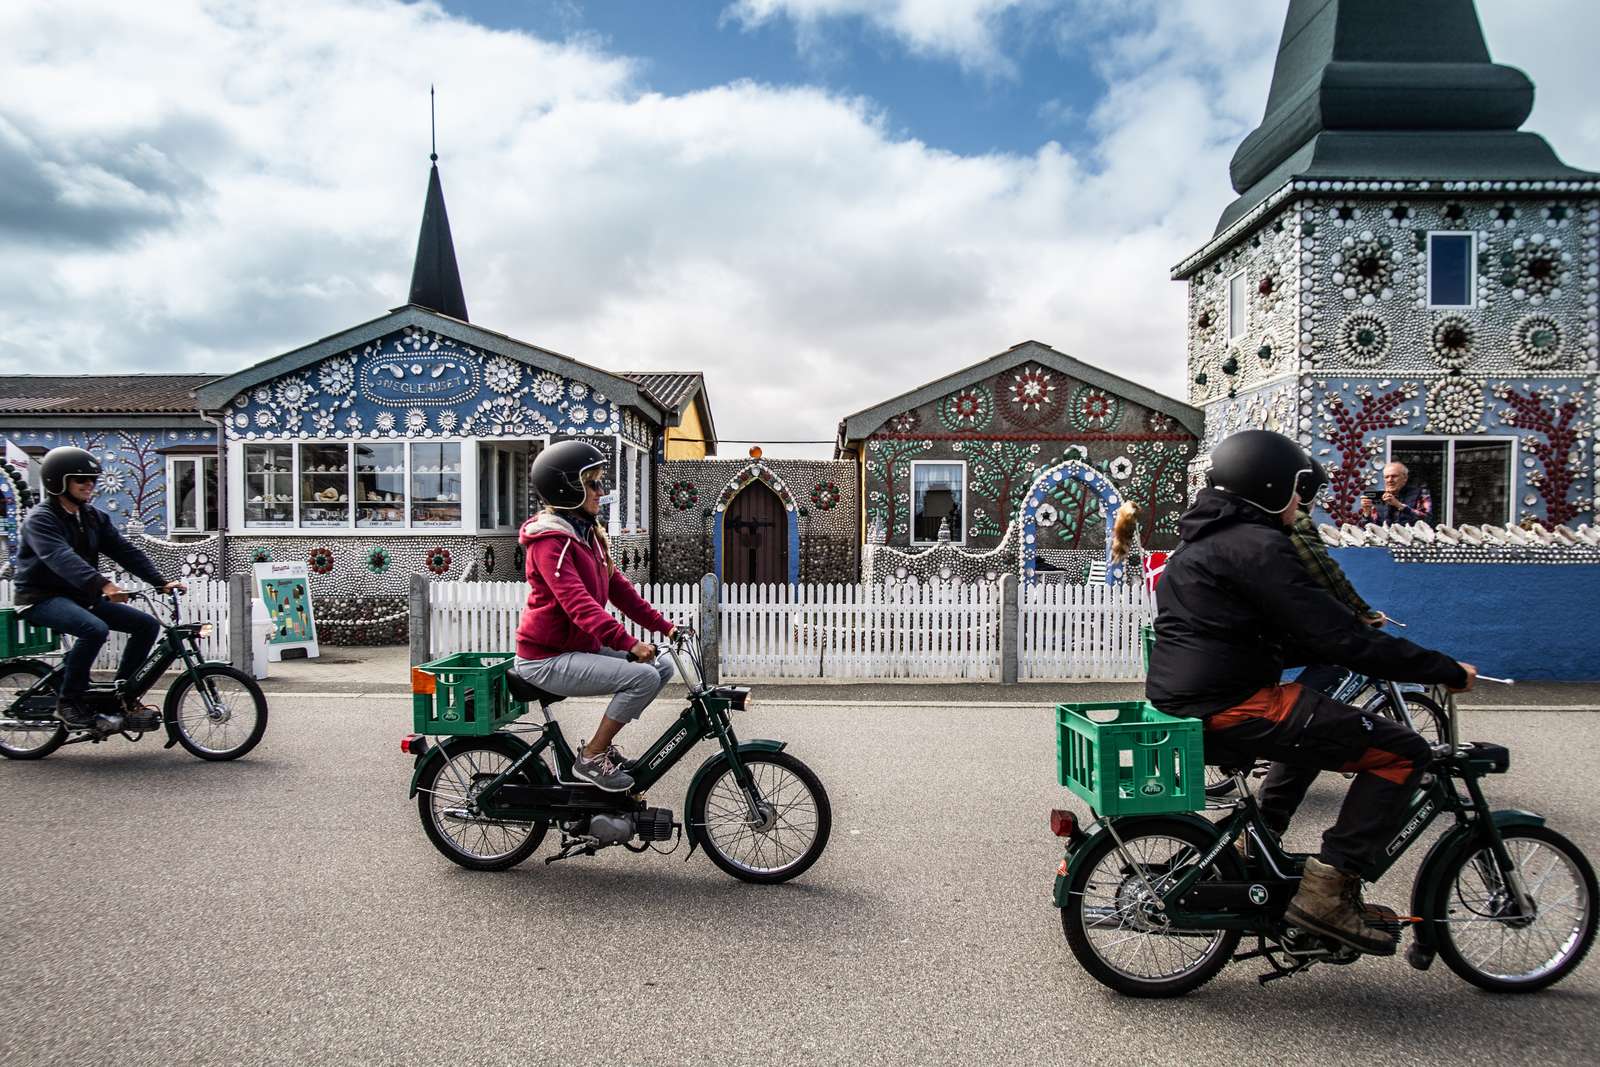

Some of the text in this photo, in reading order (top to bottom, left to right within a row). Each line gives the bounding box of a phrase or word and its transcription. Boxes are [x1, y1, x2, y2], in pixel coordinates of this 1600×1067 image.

[375, 376, 461, 394] SNEGLEHUSET
[1340, 681, 1359, 700] PUCH
[660, 741, 676, 758] PUCH
[1400, 818, 1420, 839] PUCH
[1199, 832, 1231, 869] FRANKENSTEIN
